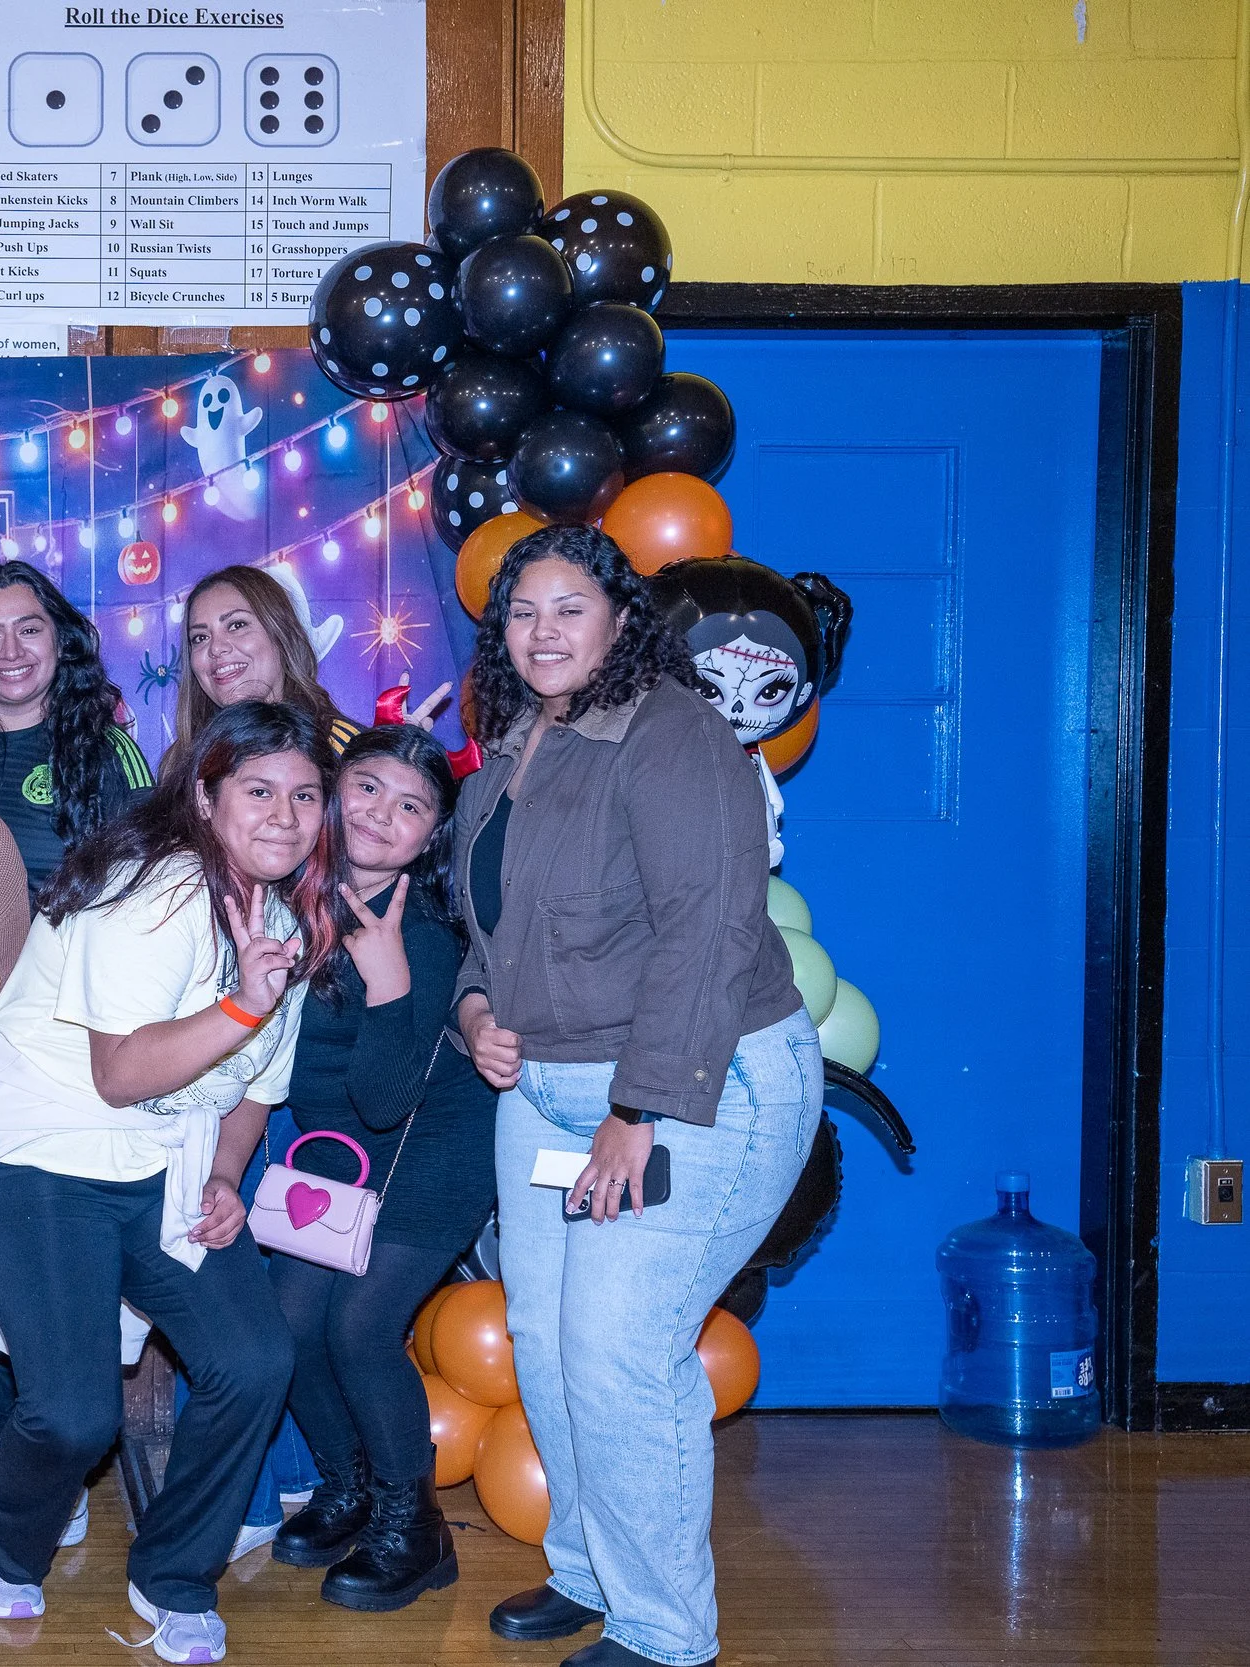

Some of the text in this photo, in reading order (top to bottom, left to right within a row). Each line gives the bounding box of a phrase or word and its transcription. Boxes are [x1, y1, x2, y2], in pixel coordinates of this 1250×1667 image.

[65, 7, 284, 25] Roll the Dice Exercises
[16, 171, 58, 182] Skaters
[110, 171, 238, 184] 7 Plank (High, Low, Side)
[252, 171, 313, 184] 13 Lunges
[57, 195, 88, 206] Kicks
[110, 195, 239, 206] 8 Mountain Climbers
[252, 195, 368, 207] 14 Inch Worm Walk
[47, 218, 79, 229] Jacks
[110, 219, 174, 230] 9 Wall Sit
[251, 219, 369, 234] 15 Touch and Jumps
[27, 242, 49, 255] Ups
[108, 242, 212, 254] 10 Russian Twists
[251, 243, 348, 257] 16 Grasshoppers
[8, 266, 39, 277] Kicks
[108, 266, 167, 280] 11 Squats
[251, 268, 263, 278] 17
[271, 267, 314, 279] Torture
[25, 292, 45, 303] ups
[108, 290, 225, 304] 12 Bicycle Crunches
[251, 291, 263, 302] 18
[271, 292, 278, 303] 5
[12, 341, 60, 352] women,
